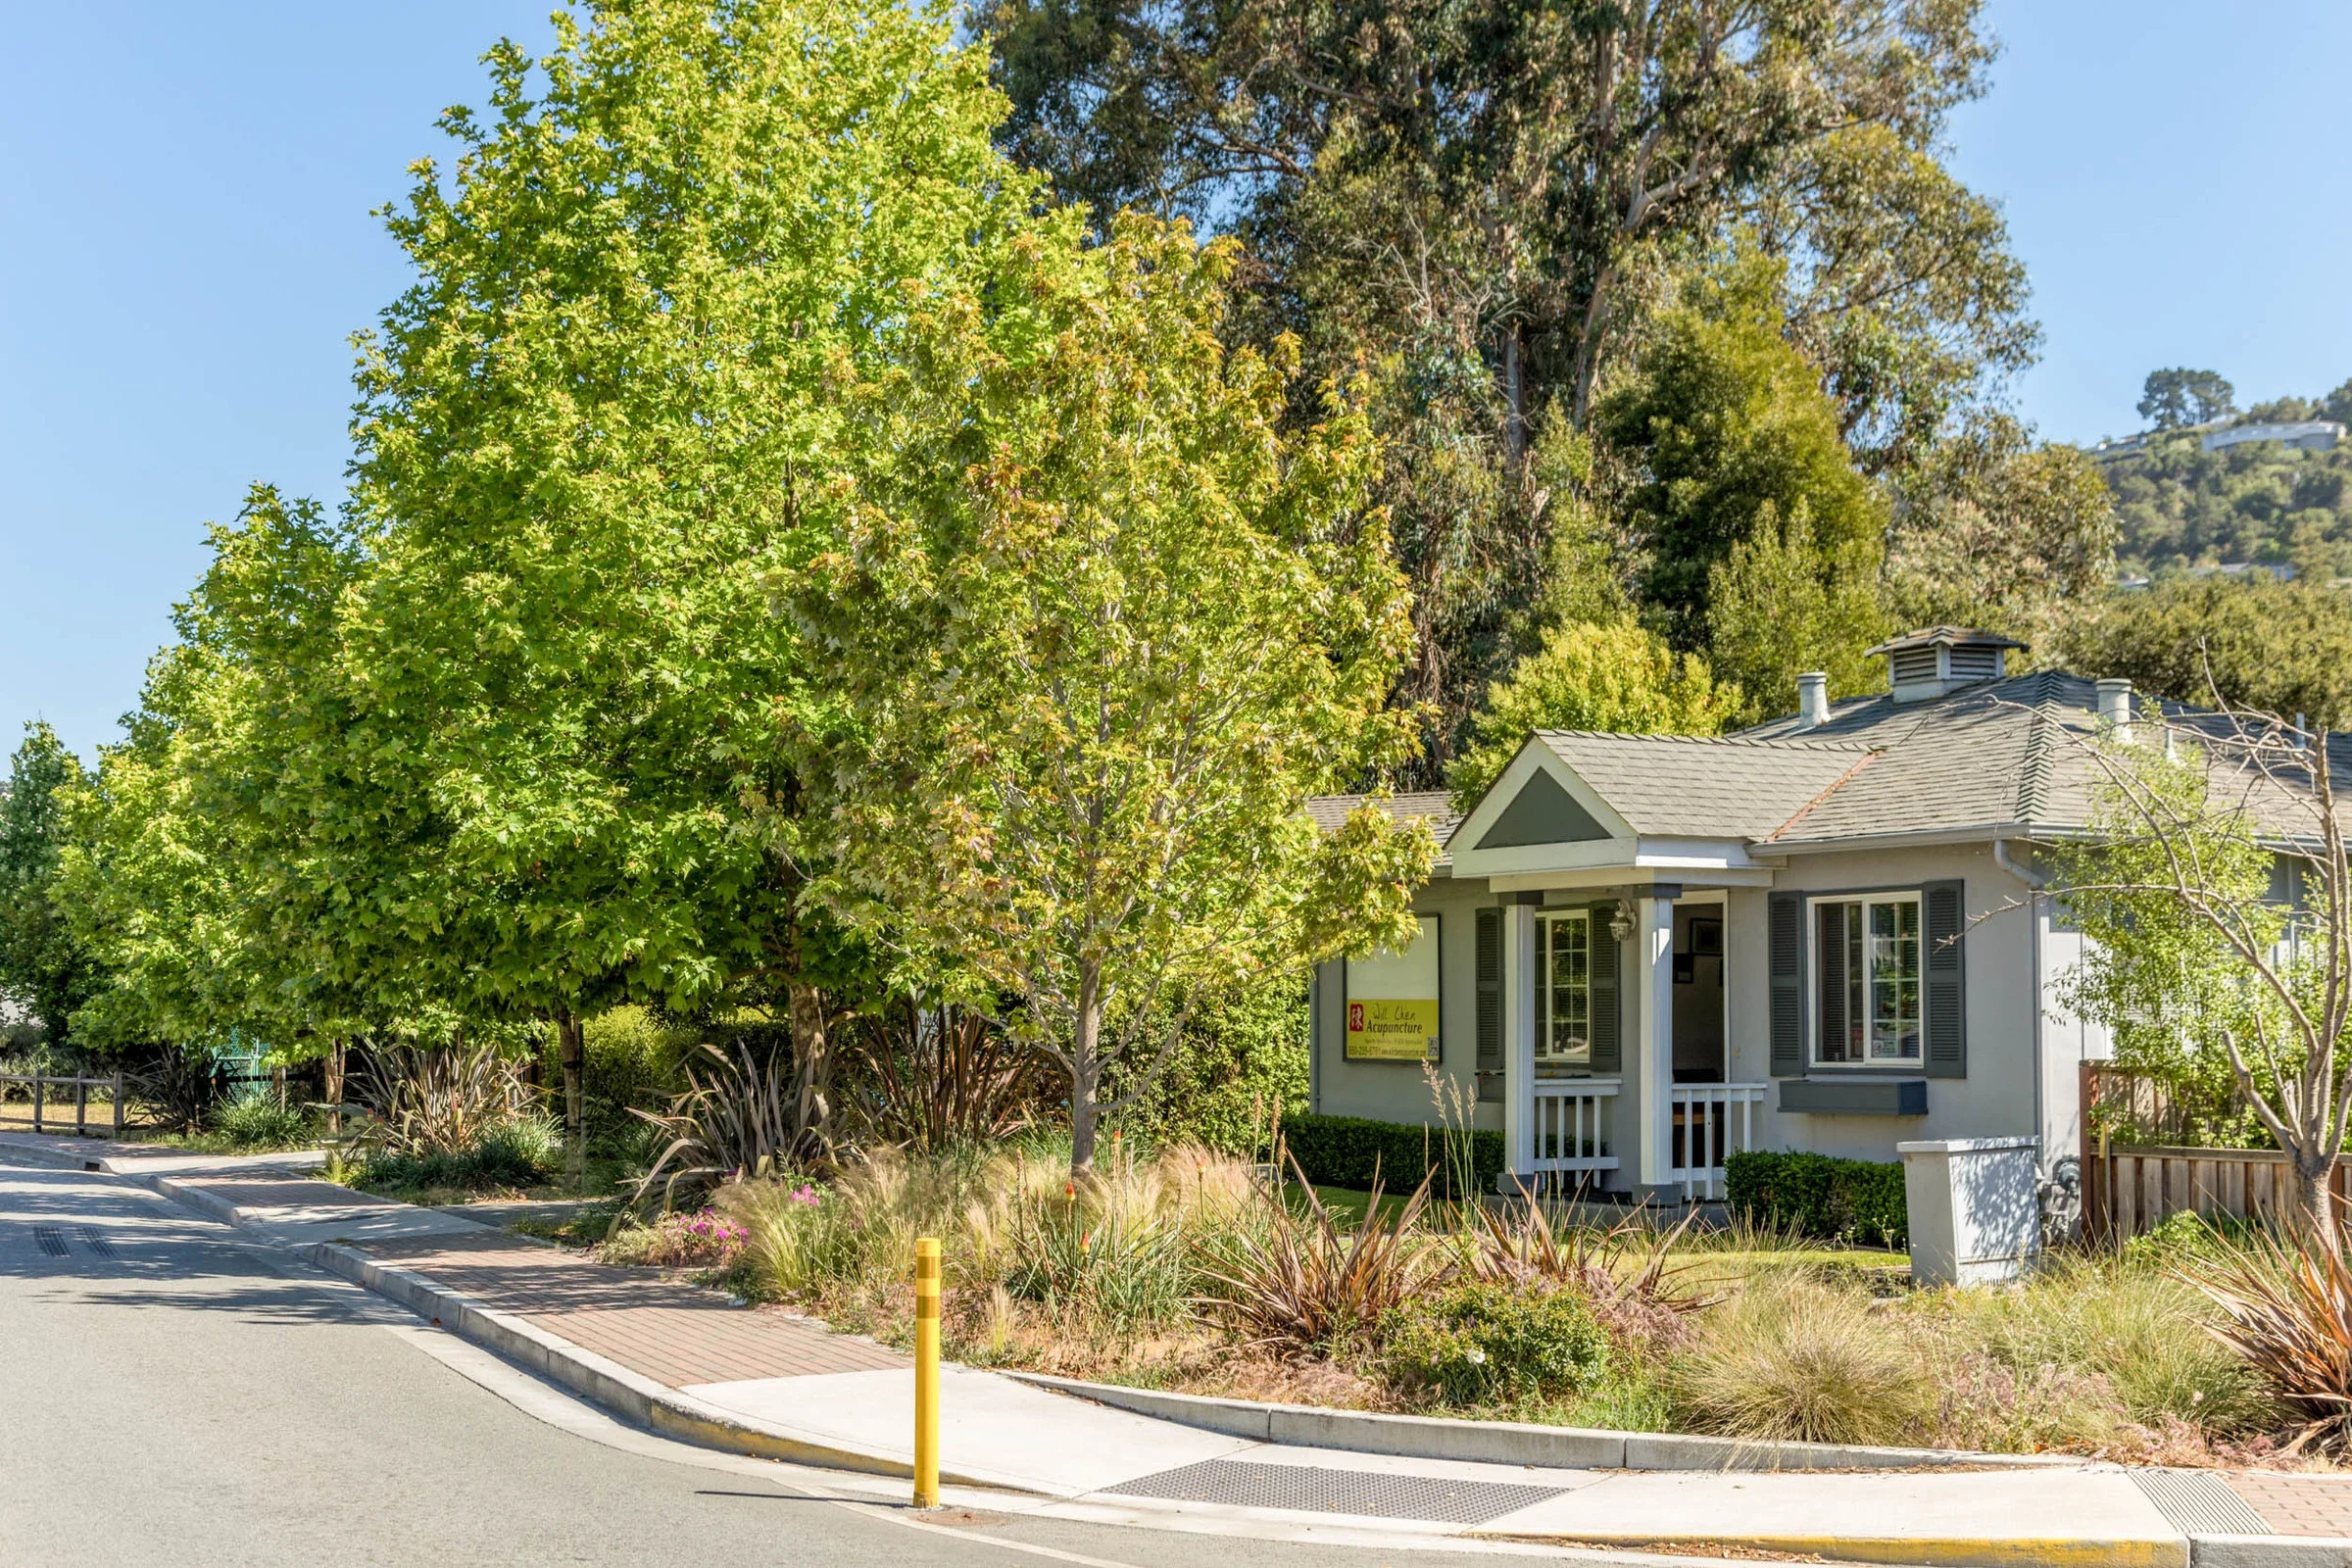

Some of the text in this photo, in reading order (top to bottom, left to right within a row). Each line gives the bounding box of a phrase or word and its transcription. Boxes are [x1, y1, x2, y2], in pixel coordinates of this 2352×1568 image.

[1373, 1003, 1416, 1021] Will Chen
[1366, 1019, 1423, 1037] Acupuncture
